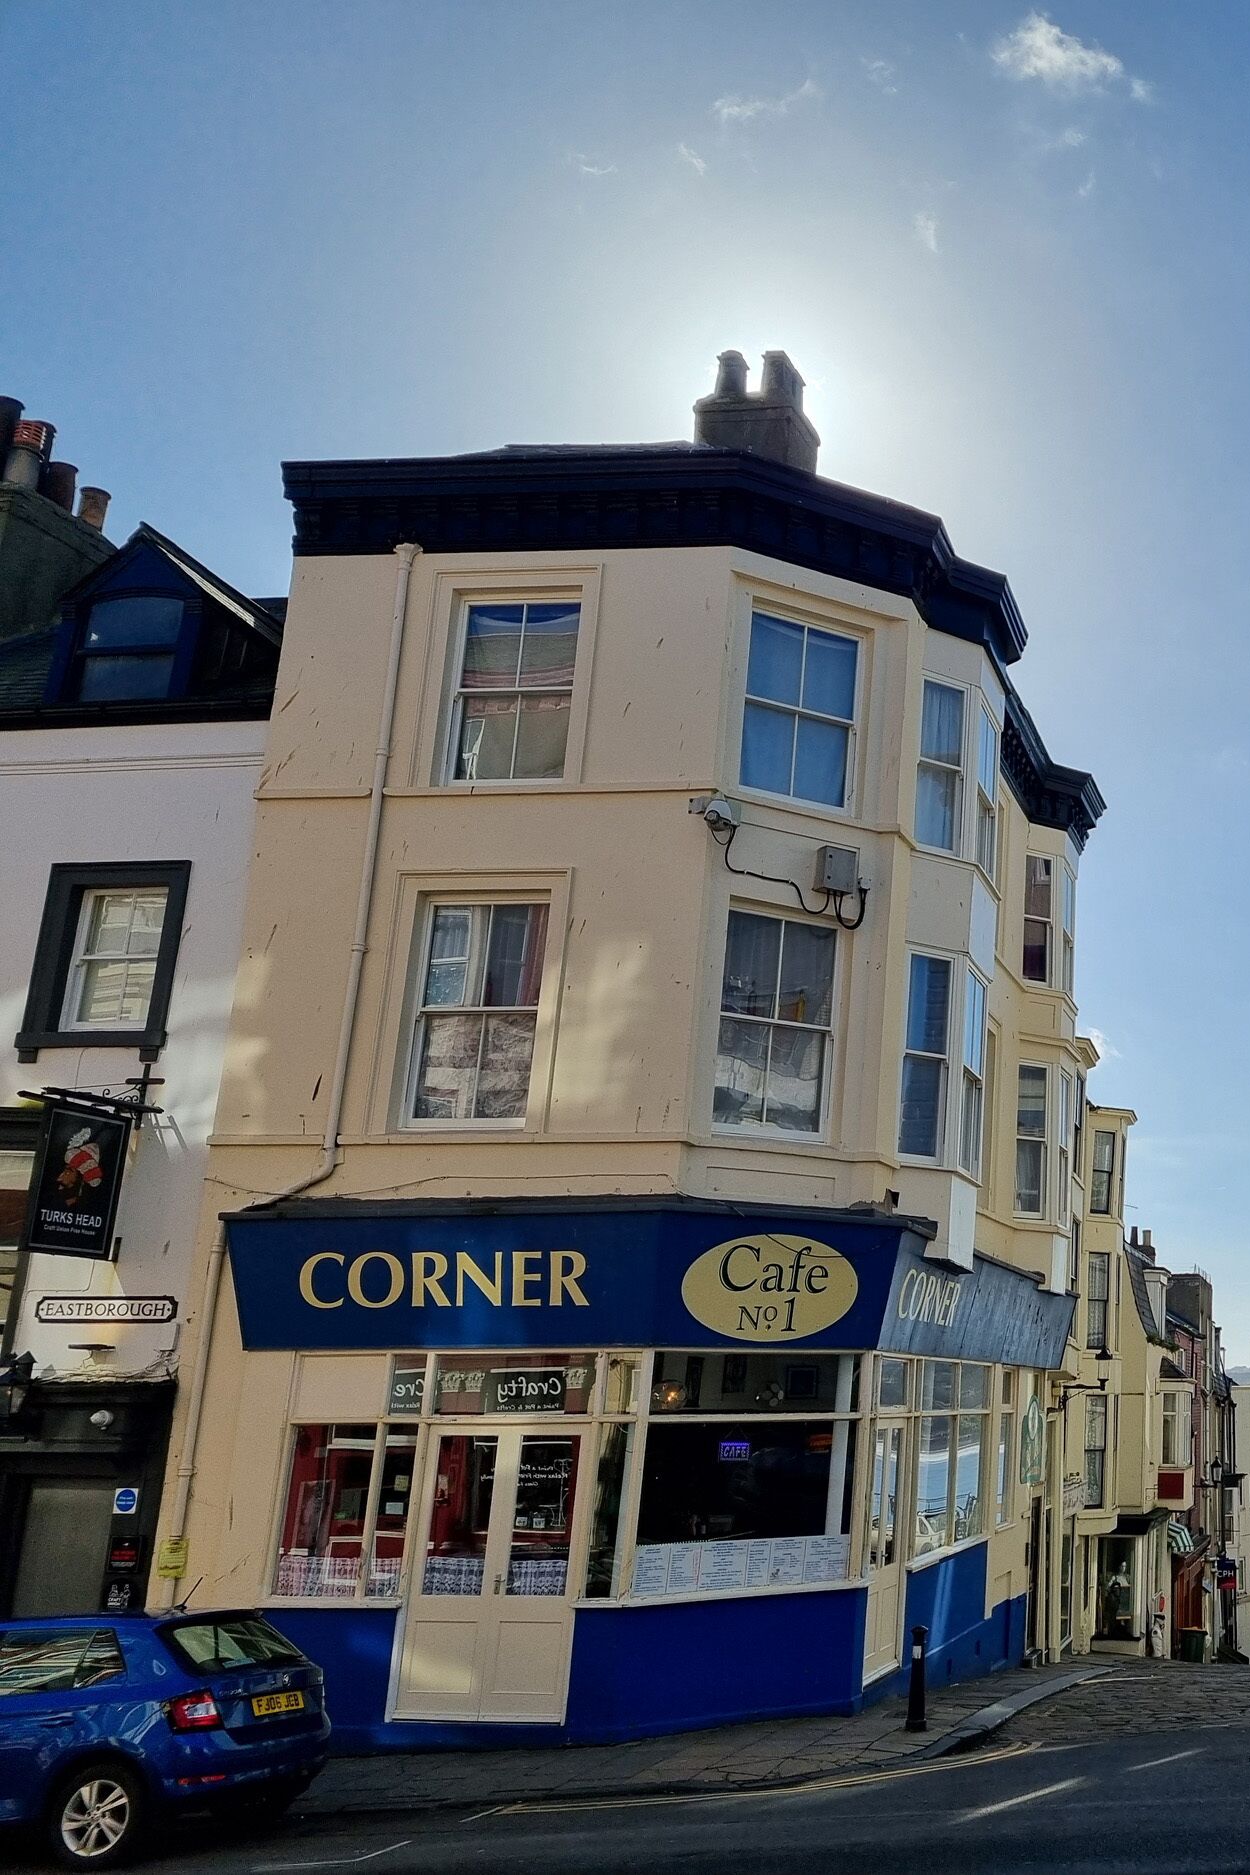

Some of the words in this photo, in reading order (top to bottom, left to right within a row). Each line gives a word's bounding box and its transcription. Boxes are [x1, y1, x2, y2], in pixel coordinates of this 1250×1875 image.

[41, 1209, 73, 1224] TURKS
[75, 1214, 102, 1227] HEAD
[299, 1251, 590, 1309] CORNER
[719, 1244, 829, 1293] Cafe
[45, 1303, 166, 1317] EASTBOROUGH
[898, 1269, 961, 1327] CORNER
